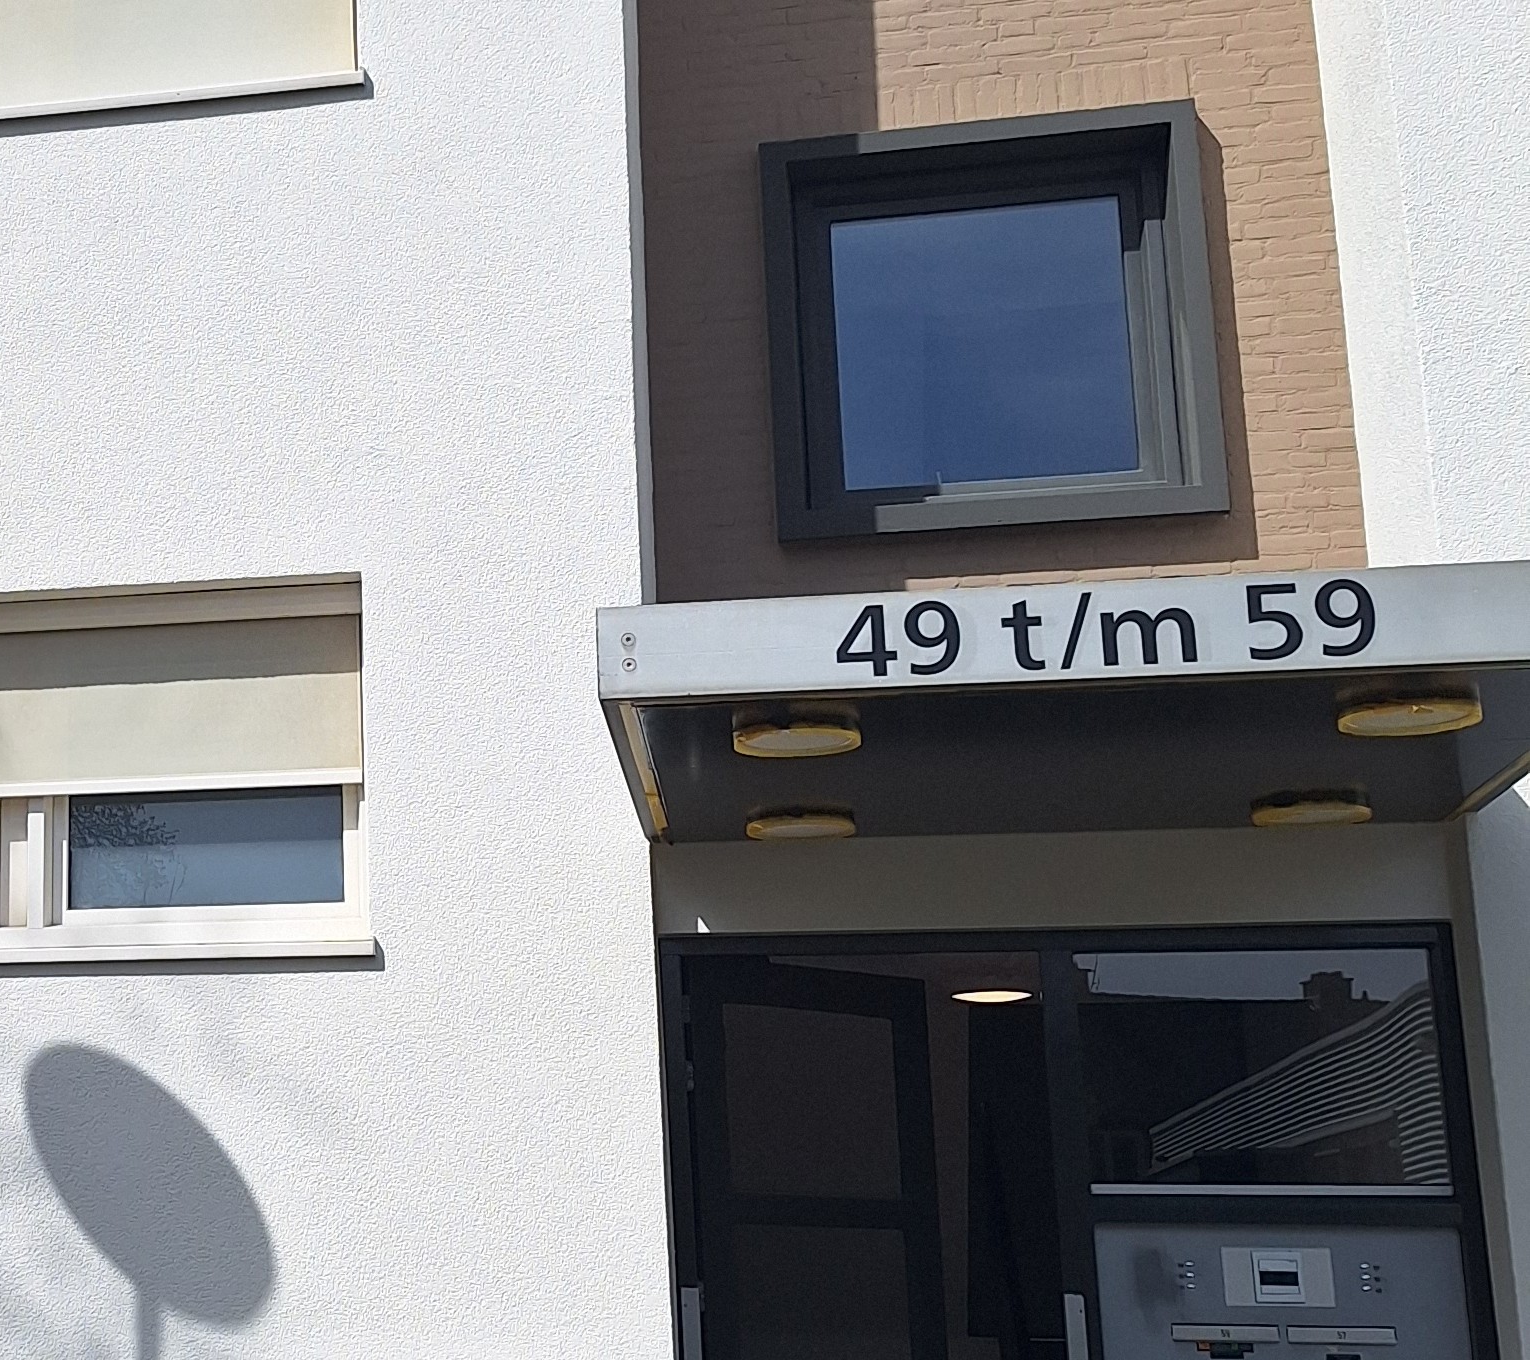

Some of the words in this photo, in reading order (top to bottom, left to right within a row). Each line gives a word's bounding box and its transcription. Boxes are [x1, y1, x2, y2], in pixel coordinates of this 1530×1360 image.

[836, 600, 961, 677] 49
[1000, 591, 1199, 671] t/m
[1245, 578, 1376, 661] 59
